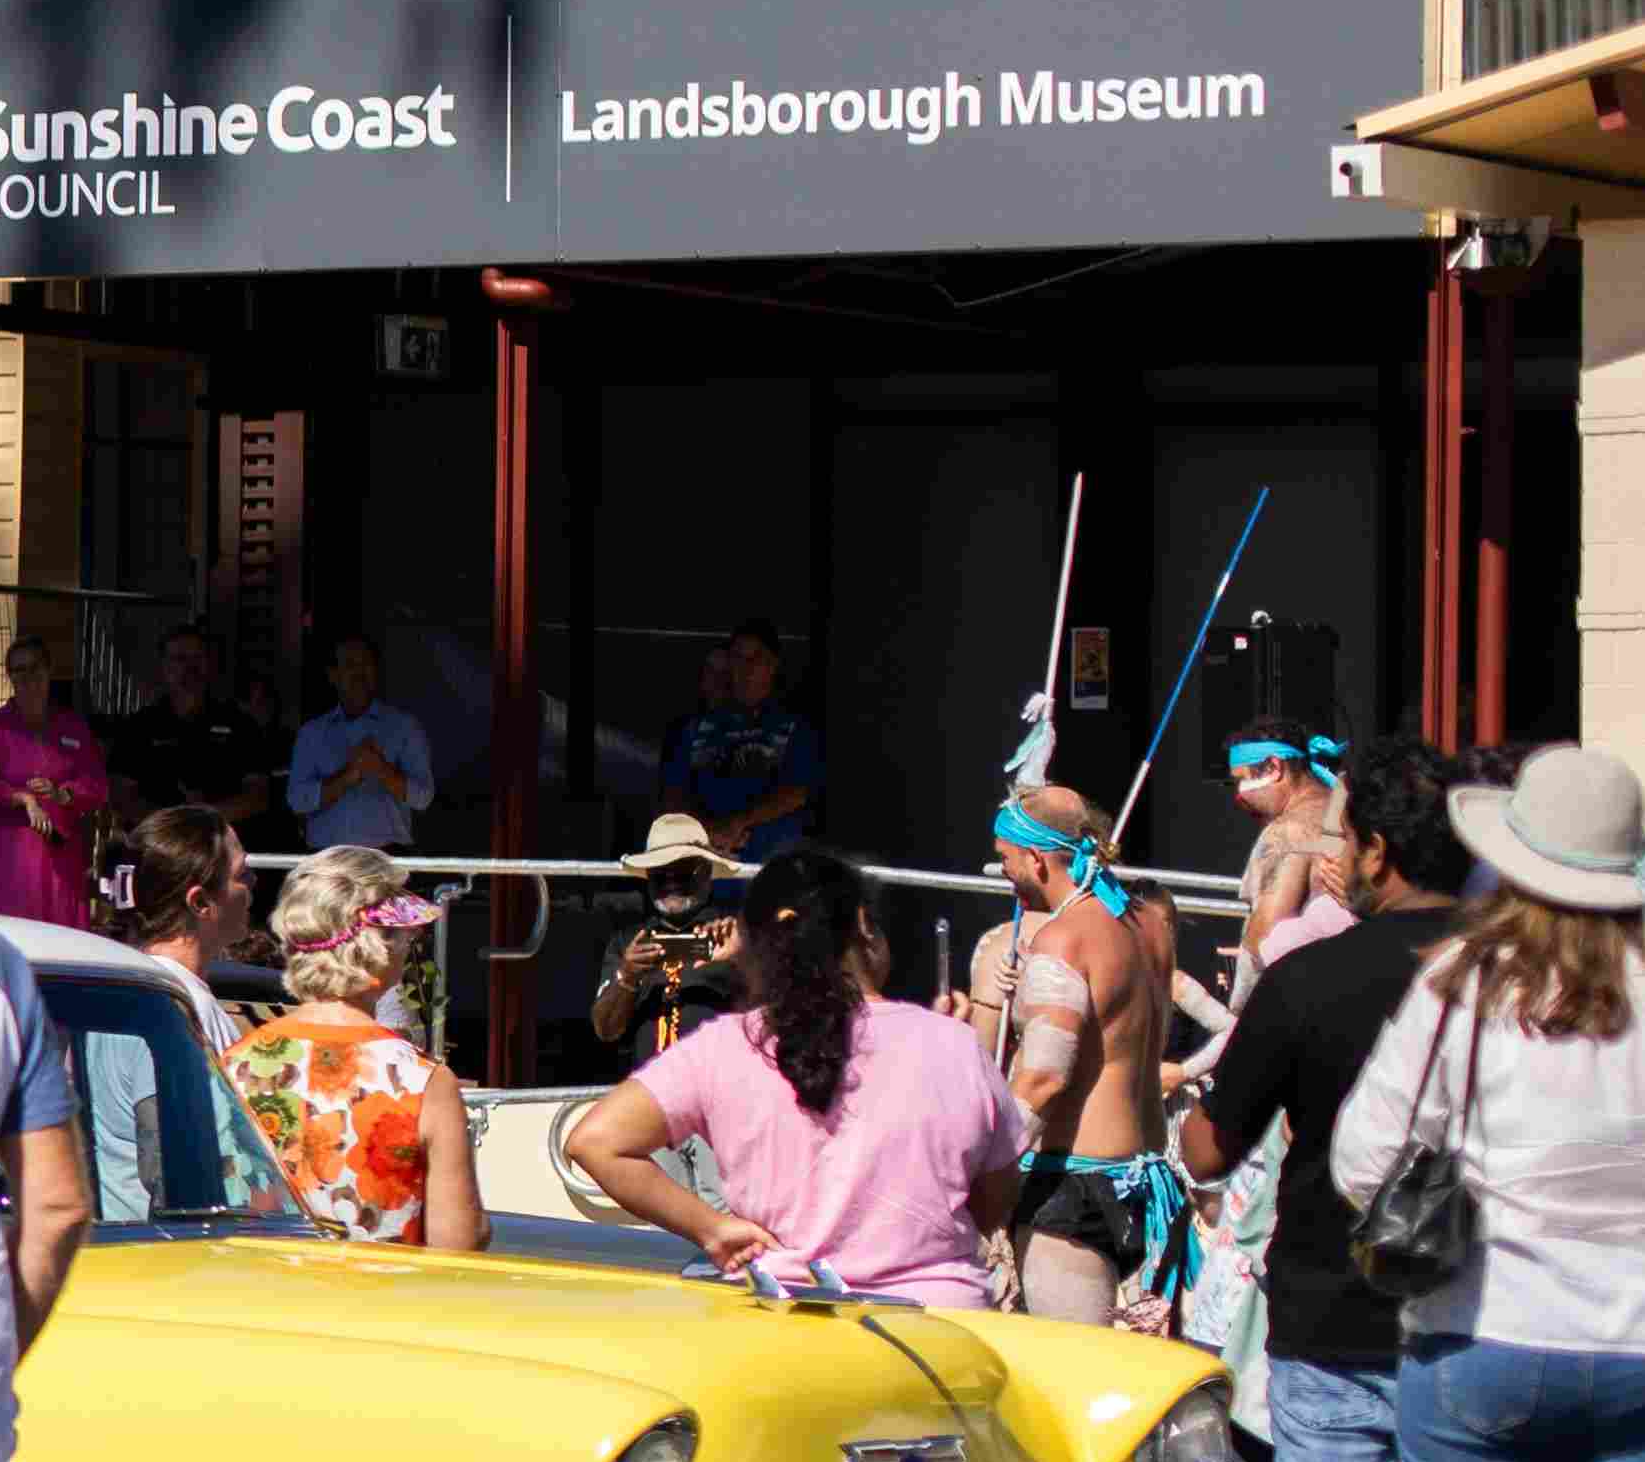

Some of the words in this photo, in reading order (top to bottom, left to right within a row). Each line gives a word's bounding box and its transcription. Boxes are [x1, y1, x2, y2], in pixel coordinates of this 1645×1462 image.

[267, 83, 457, 153] Coast
[561, 72, 981, 144] Landsborough
[1000, 69, 1265, 128] Museum
